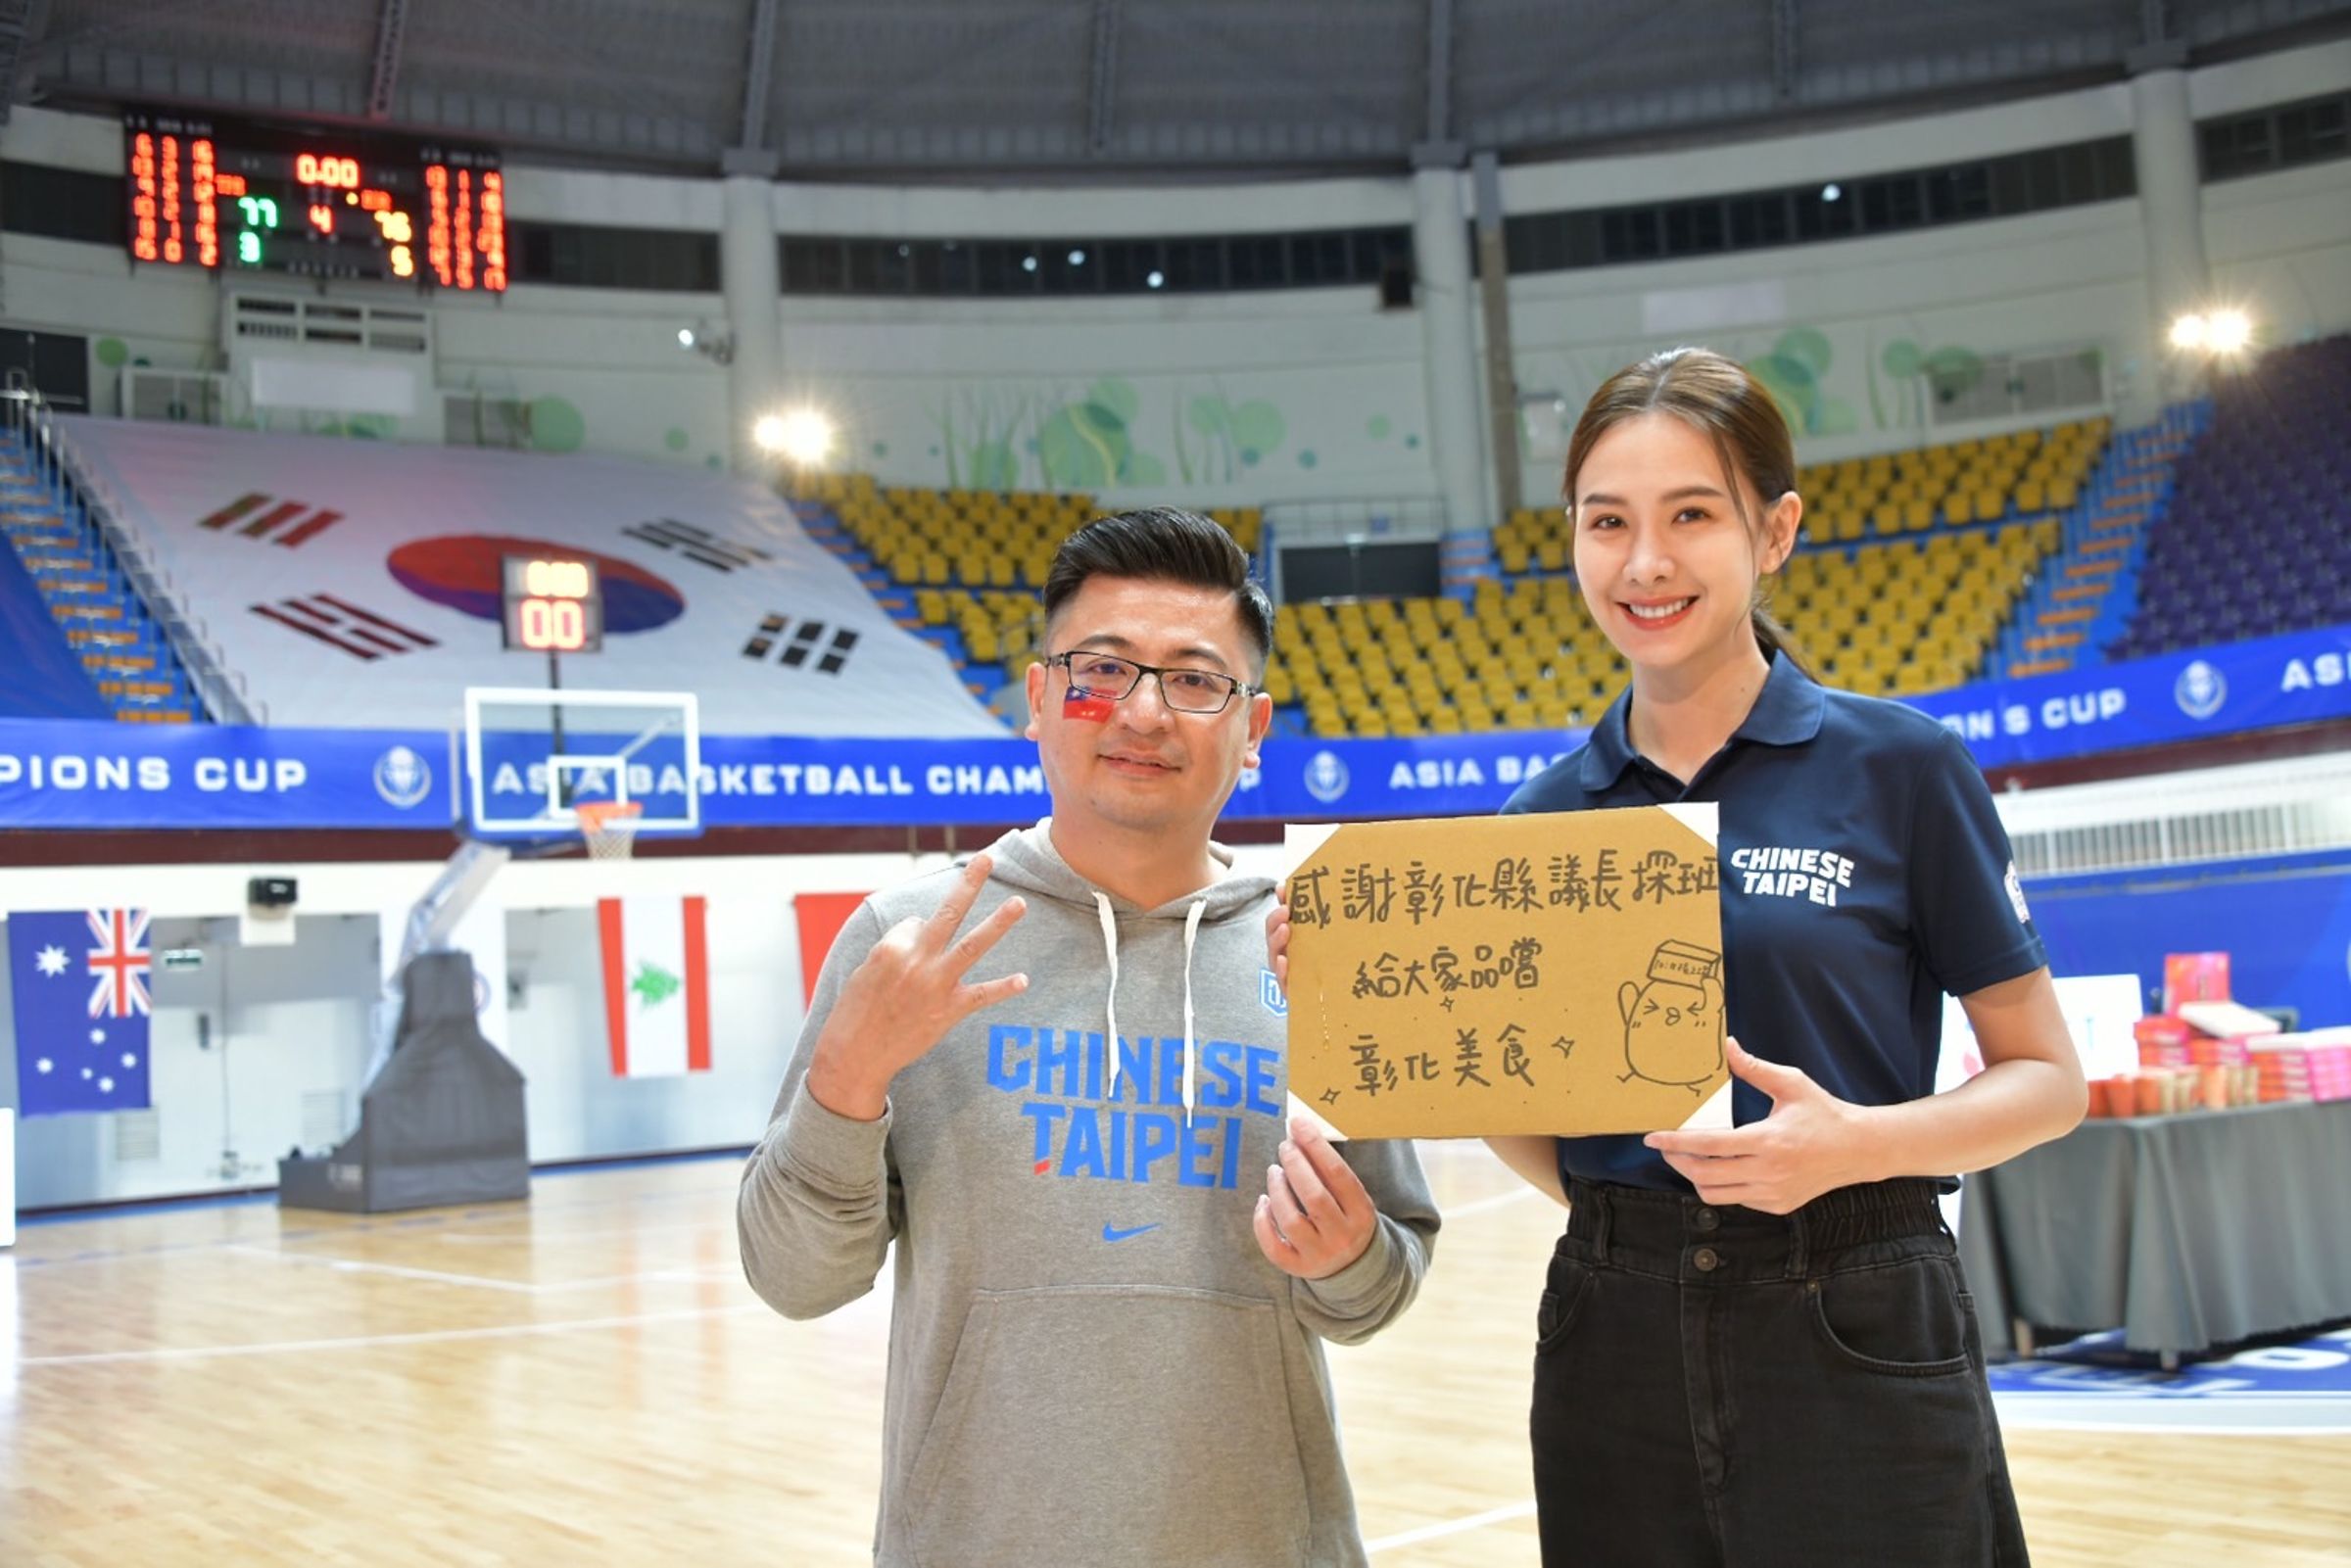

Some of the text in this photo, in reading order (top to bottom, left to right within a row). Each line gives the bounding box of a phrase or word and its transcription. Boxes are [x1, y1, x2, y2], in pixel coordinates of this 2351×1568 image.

[238, 196, 277, 228] 77
[309, 204, 332, 234] 4
[521, 598, 585, 650] 00
[2041, 689, 2127, 728] CUP
[195, 757, 308, 792] CUP
[627, 764, 913, 795] BASKETBALL
[1389, 753, 1568, 789] ASIA BA
[1731, 847, 1854, 888] CHINESE
[1288, 849, 1719, 929] 感謝彰化縣議長探班
[1743, 873, 1837, 908] TAIPEI
[1352, 936, 1543, 999] 給大家品嚐
[986, 1024, 1280, 1117] CHINESE
[1349, 1022, 1535, 1097] 彰化美食
[1021, 1102, 1242, 1189] TAIPEI
